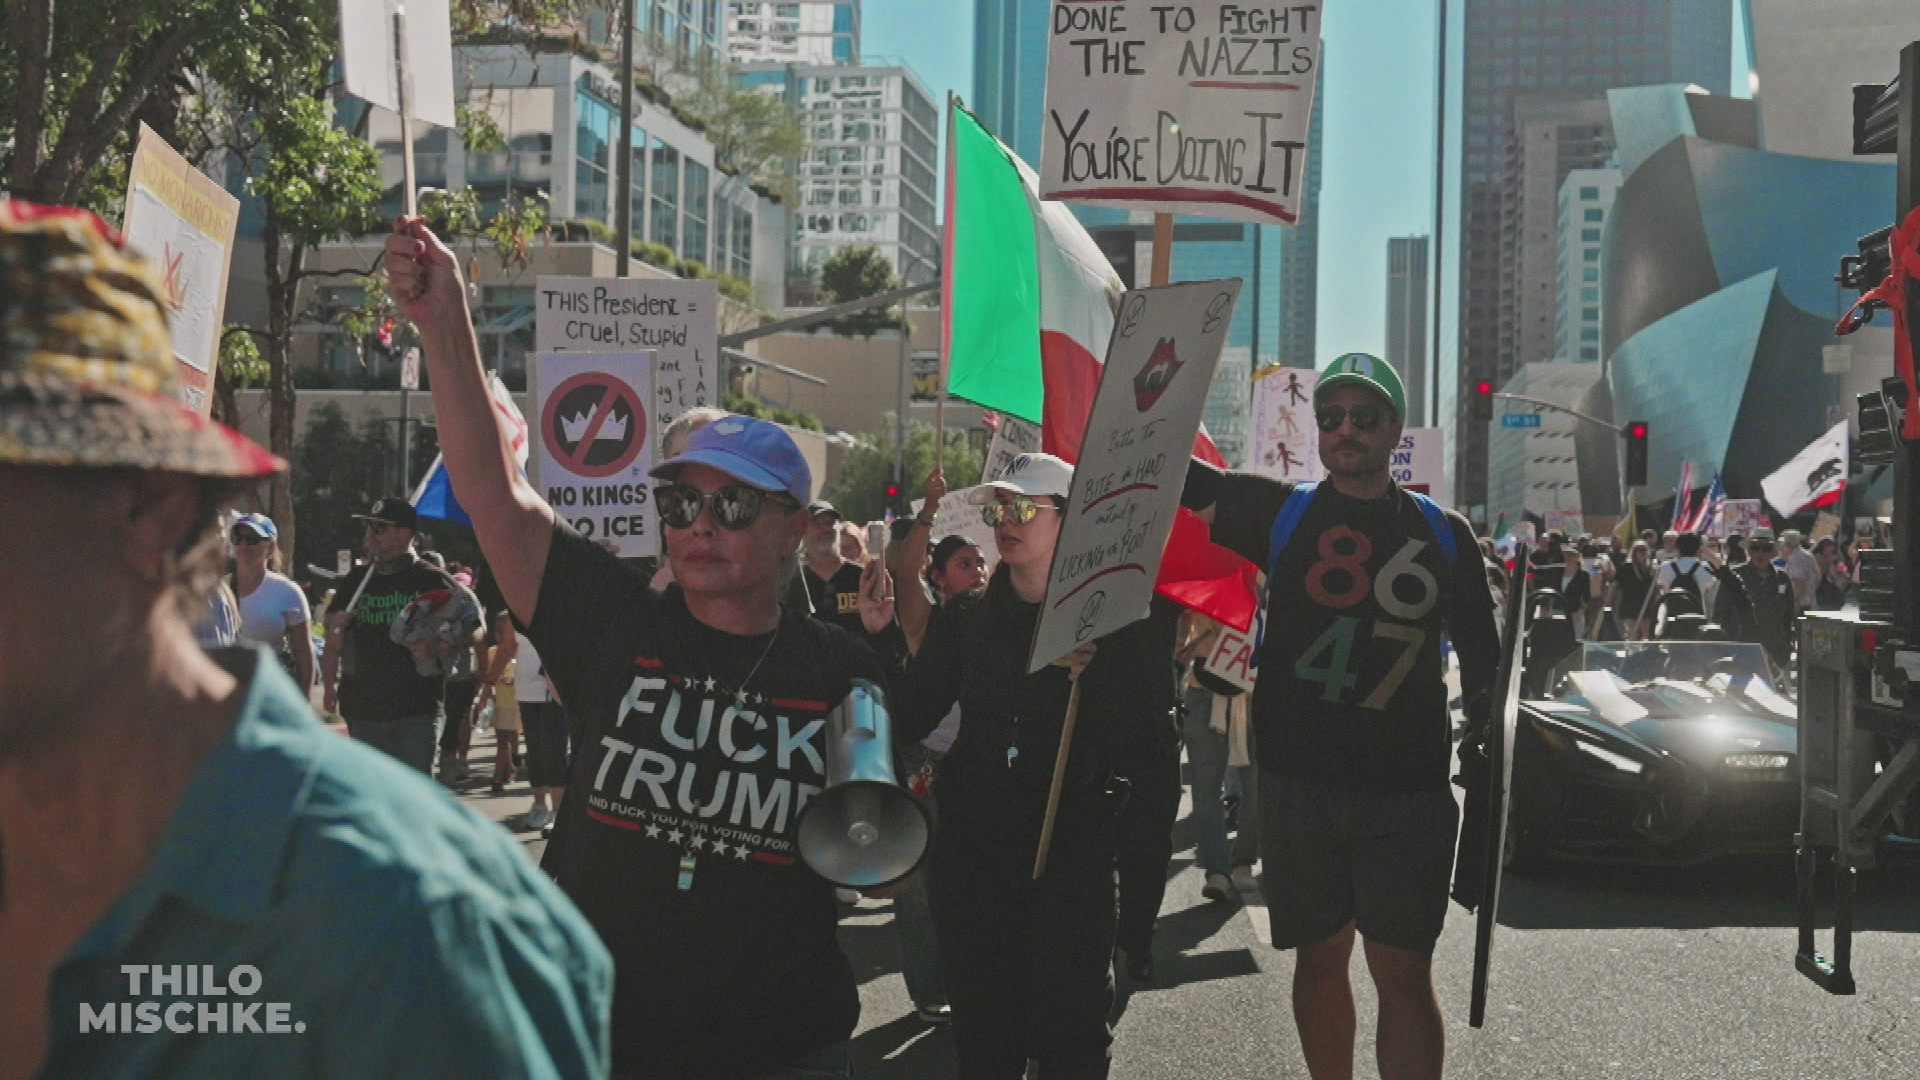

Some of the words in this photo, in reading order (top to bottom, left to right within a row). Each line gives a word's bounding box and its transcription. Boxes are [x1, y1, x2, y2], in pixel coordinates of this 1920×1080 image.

[1054, 5, 1127, 35] DONE
[1150, 6, 1196, 33] TO
[1219, 5, 1317, 35] FIGHT
[1069, 38, 1146, 77] THE
[1156, 110, 1246, 186] DOING
[1243, 111, 1305, 197] IT
[542, 290, 590, 314] THIS
[594, 286, 681, 316] President
[629, 322, 688, 348] Stupid
[1350, 356, 1365, 375] L
[548, 486, 577, 506] NO
[582, 483, 648, 506] KINGS
[1083, 472, 1115, 503] BITE
[603, 516, 644, 536] ICE
[1305, 524, 1439, 620] 86
[1294, 614, 1427, 710] 47
[616, 675, 826, 776] FUCK
[588, 794, 608, 810] AND
[611, 802, 646, 819] FUCK
[651, 812, 679, 826] YOU
[712, 826, 762, 845] VOTING
